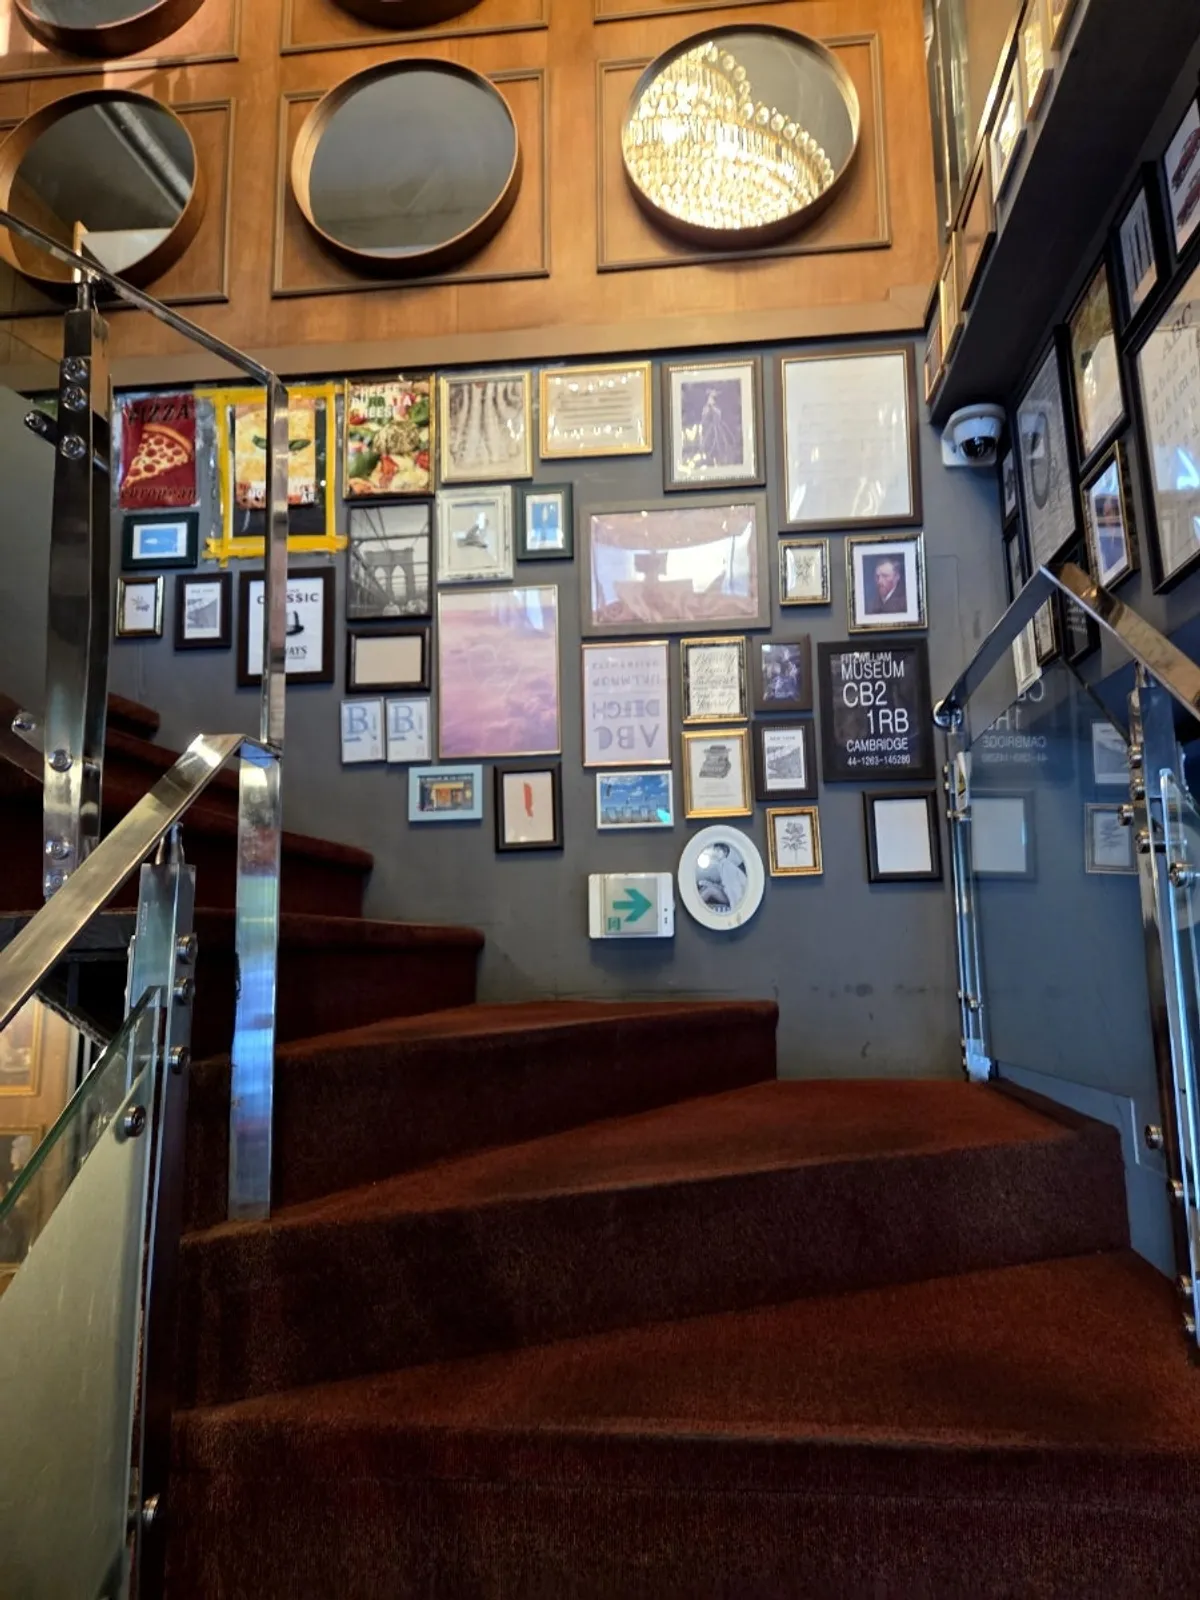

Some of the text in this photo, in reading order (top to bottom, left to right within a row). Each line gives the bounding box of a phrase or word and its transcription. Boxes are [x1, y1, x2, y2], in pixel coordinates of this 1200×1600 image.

[128, 402, 190, 424] PIZZA
[257, 592, 319, 605] CSSIC
[841, 660, 905, 680] MUSEUM
[842, 680, 888, 708] CB2
[867, 708, 910, 735] 1RB
[846, 738, 909, 753] CAMBRIDGE
